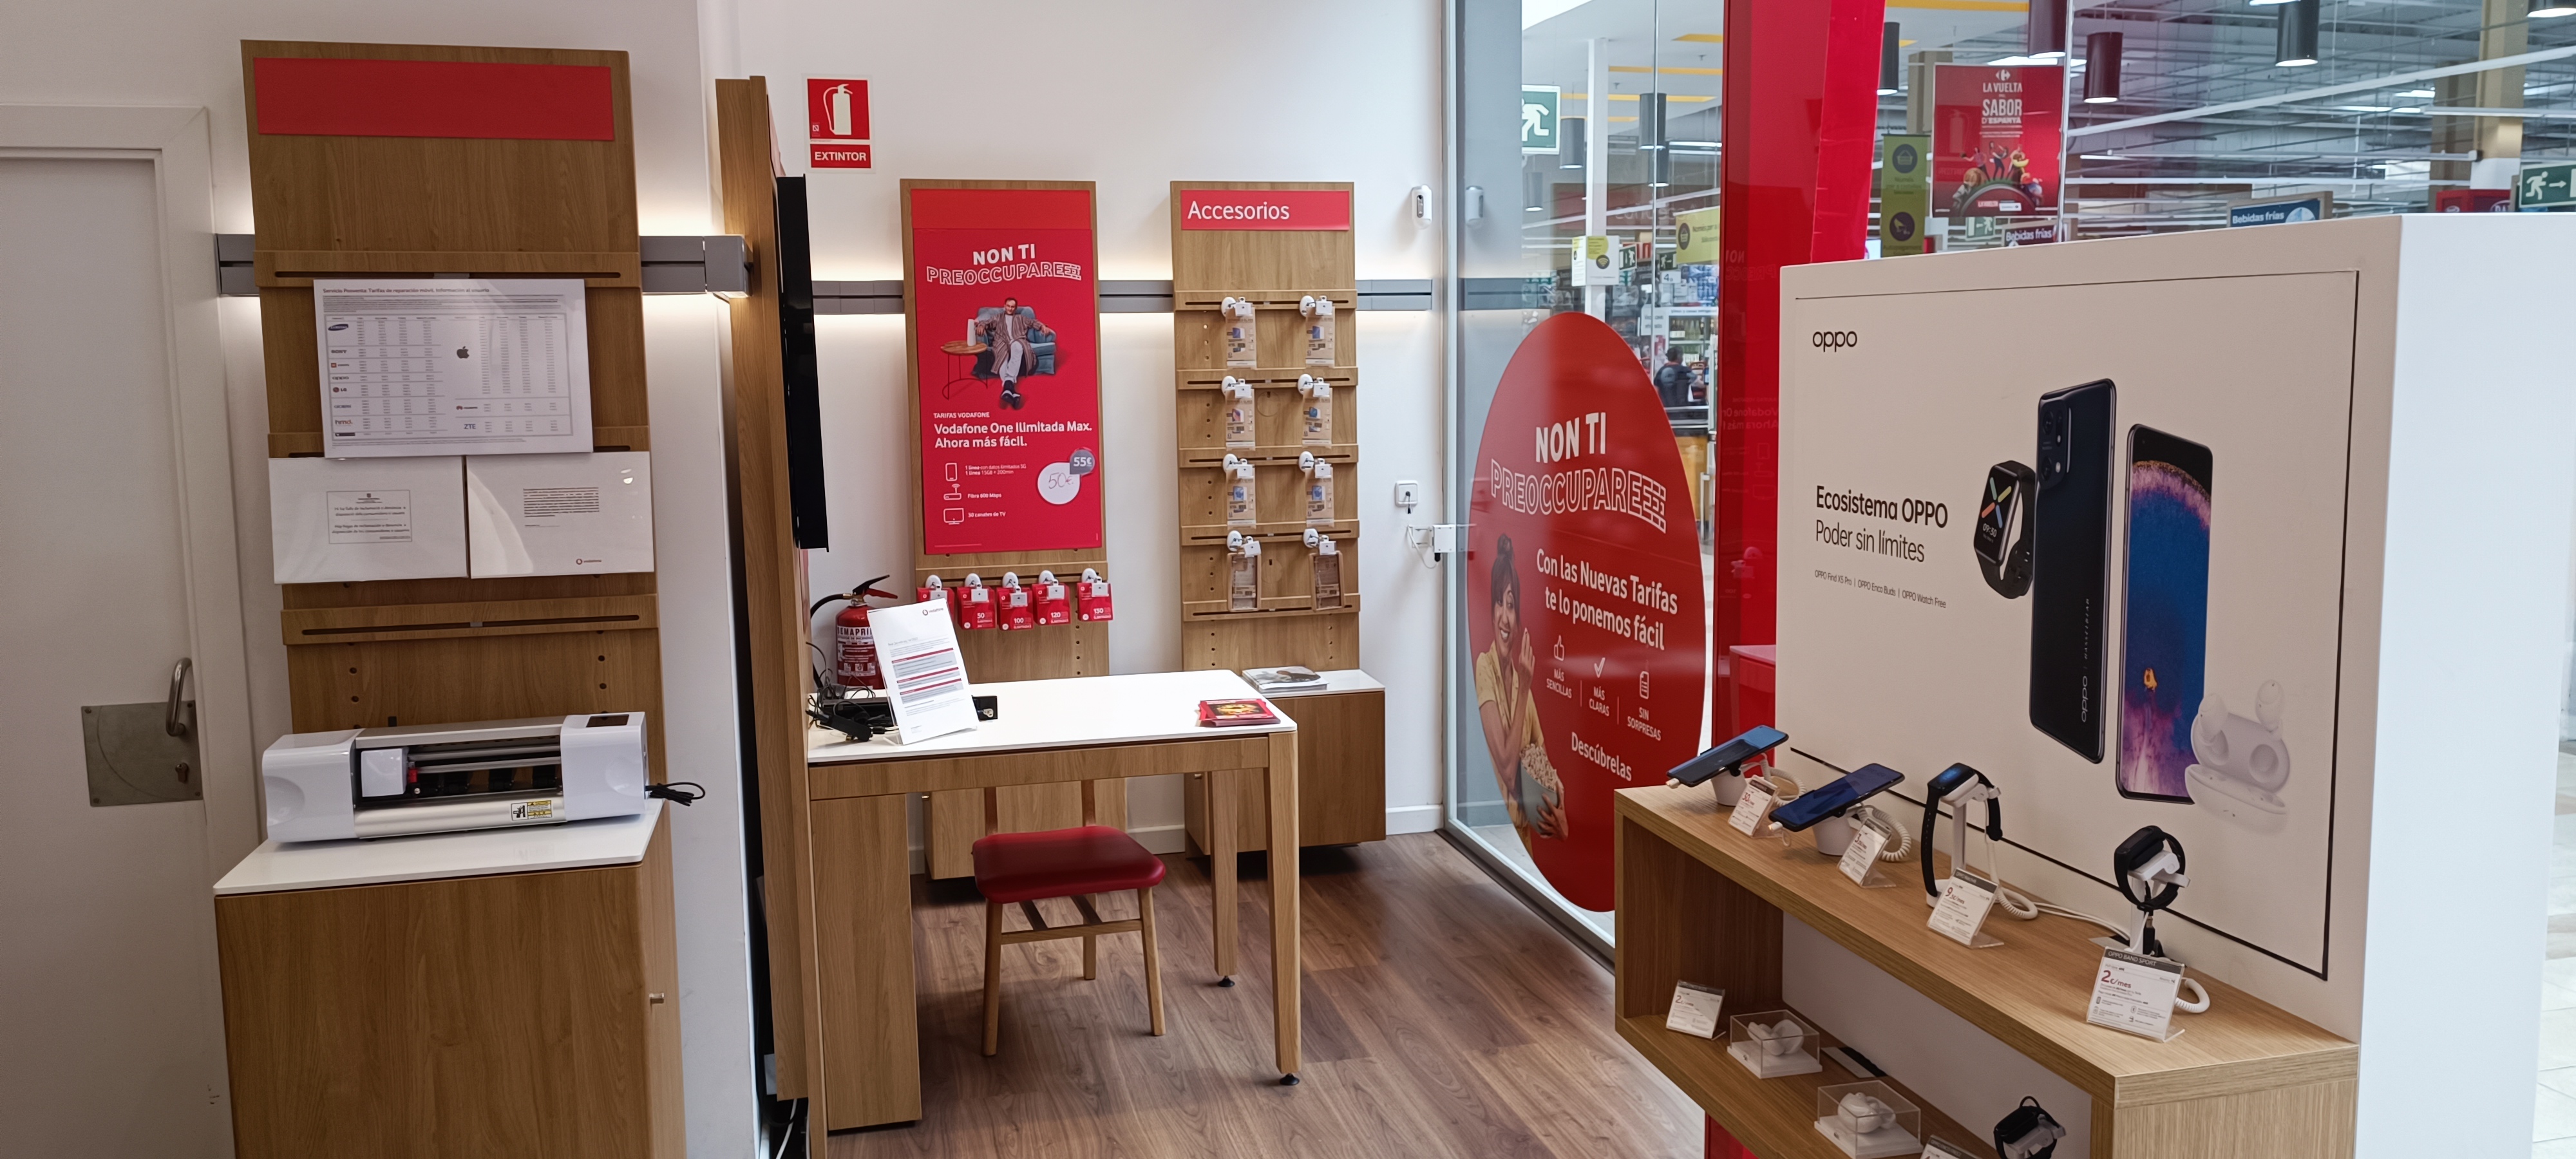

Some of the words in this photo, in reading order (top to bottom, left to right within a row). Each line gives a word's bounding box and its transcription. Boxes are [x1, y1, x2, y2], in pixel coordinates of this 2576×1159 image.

[1983, 82, 1992, 92] LA
[1993, 82, 2023, 92] VUELTA
[1982, 99, 2022, 116] SABOR
[815, 151, 867, 161] EXTINTOR
[1188, 201, 1289, 220] Accesorios
[2232, 213, 2264, 223] Bebidas
[2266, 211, 2284, 220] frías
[2006, 230, 2034, 241] Bebidas
[2035, 228, 2052, 238] frías
[973, 247, 1013, 265] NON
[1018, 243, 1036, 259] TI
[1812, 331, 1858, 352] oppo
[934, 423, 988, 435] Vodafone
[990, 422, 1014, 433] One
[1016, 421, 1065, 433] Ilimitada
[1067, 420, 1093, 432] Max.
[935, 437, 970, 448] Ahora
[972, 437, 997, 448] más
[999, 435, 1027, 447] fácil.
[1535, 417, 1580, 464] NON
[1586, 412, 1606, 455] TI
[1073, 457, 1092, 467] 55€
[1816, 485, 1898, 521] Ecosistema
[1902, 498, 1948, 529] OPPO
[1982, 523, 1997, 538] 09:30
[1816, 519, 1853, 548] Poder
[1855, 528, 1875, 553] sin
[1879, 529, 1925, 563] límites
[1537, 548, 1558, 577] Con
[1560, 554, 1578, 583] las
[1580, 560, 1627, 599] Nuevas
[1630, 574, 1678, 615] Tarifas
[1815, 569, 1827, 580] OPPO
[1827, 572, 1837, 583] Find
[1837, 575, 1844, 584] X5
[1857, 580, 1871, 590] OPPO
[1884, 585, 1896, 596] Buds
[1902, 590, 1917, 601] OPPO
[1917, 594, 1933, 605] Watch
[1935, 597, 1946, 608] Free
[1545, 587, 1557, 610] te
[1559, 589, 1570, 616] lo
[1573, 599, 1631, 638] ponemos
[1634, 614, 1665, 650] fácil
[1554, 668, 1564, 682] MÁS
[1546, 678, 1572, 699] SENCILLAS
[1593, 686, 1605, 701] MÁS
[1589, 698, 1609, 717] CLARAS
[1639, 707, 1649, 721] SIN
[1627, 716, 1662, 741] SORPRESAS
[1571, 731, 1632, 782] Descúbrelas
[2123, 954, 2138, 963] BAND
[2139, 958, 2157, 966] SPORT
